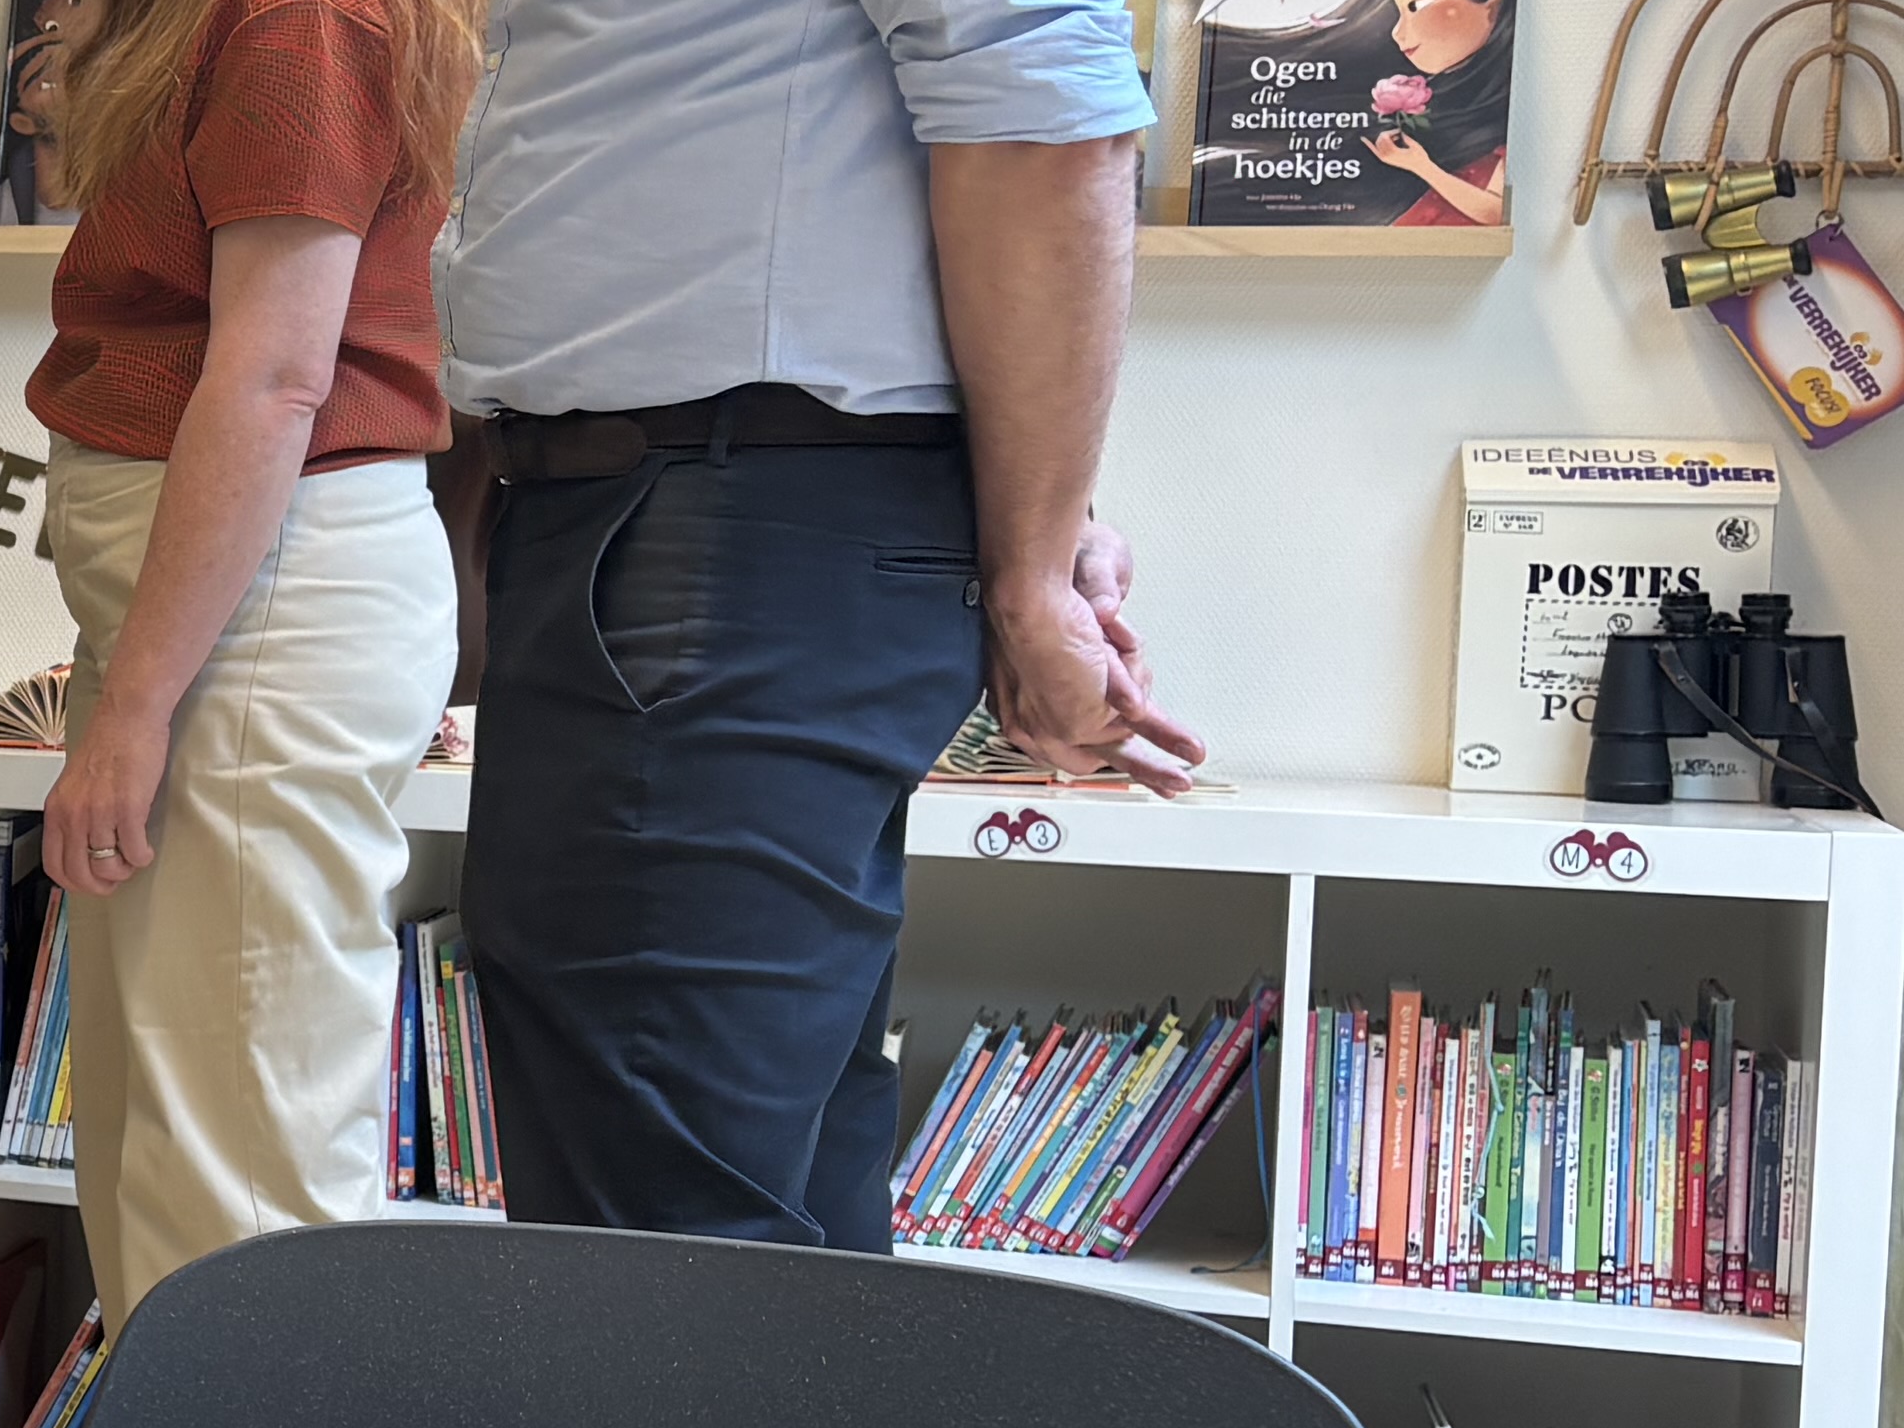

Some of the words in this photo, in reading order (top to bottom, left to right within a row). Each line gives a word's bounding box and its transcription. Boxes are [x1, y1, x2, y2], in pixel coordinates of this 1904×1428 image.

[1250, 56, 1337, 88] Ogen
[1250, 86, 1285, 105] die
[1231, 107, 1369, 130] schitteren
[1288, 132, 1309, 151] in
[1316, 131, 1343, 151] de
[1234, 153, 1361, 185] hoekjes
[1789, 287, 1882, 401] VERREKIJKER
[1473, 446, 1658, 464] IDEEËNBUS
[1528, 467, 1552, 476] DE
[1556, 465, 1776, 488] VERREKIJKER
[1526, 562, 1702, 599] POSTES
[1036, 824, 1051, 846] 3
[1561, 845, 1581, 870] M
[1620, 851, 1634, 874] 4
